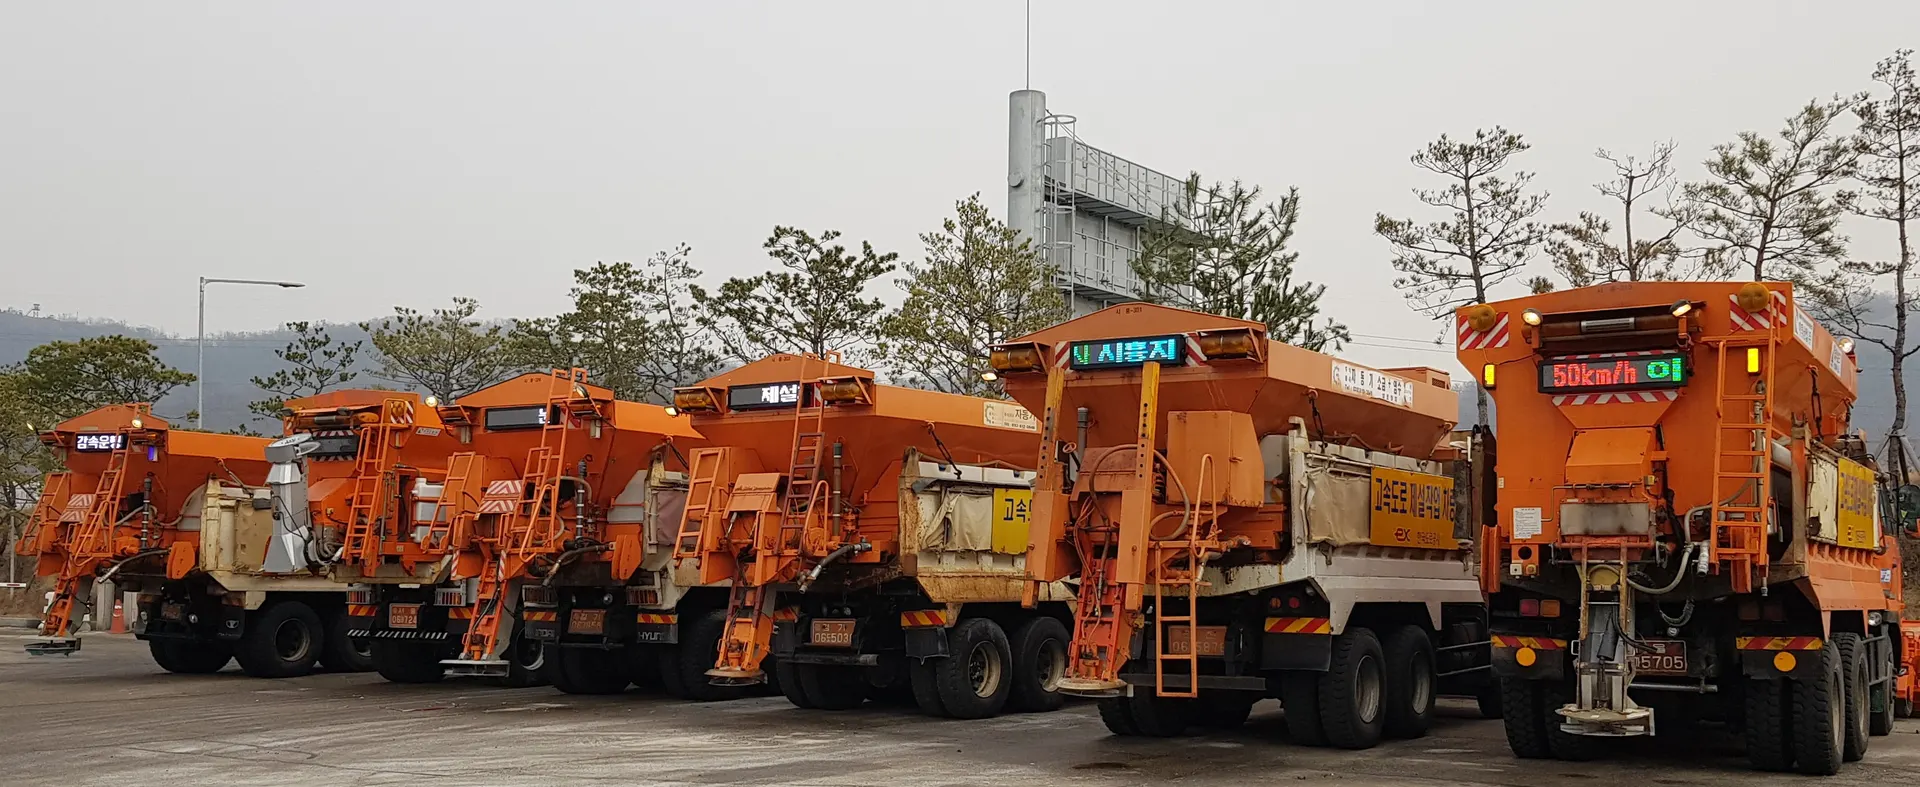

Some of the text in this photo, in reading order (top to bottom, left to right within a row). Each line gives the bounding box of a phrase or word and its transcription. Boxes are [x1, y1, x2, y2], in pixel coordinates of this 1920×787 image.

[1098, 339, 1176, 362] 시흥지
[1553, 361, 1637, 387] 50km/h
[761, 384, 800, 403] 제설
[1375, 478, 1407, 514] 고속도로
[1410, 483, 1440, 520] 제설작업
[1394, 527, 1411, 542] ex
